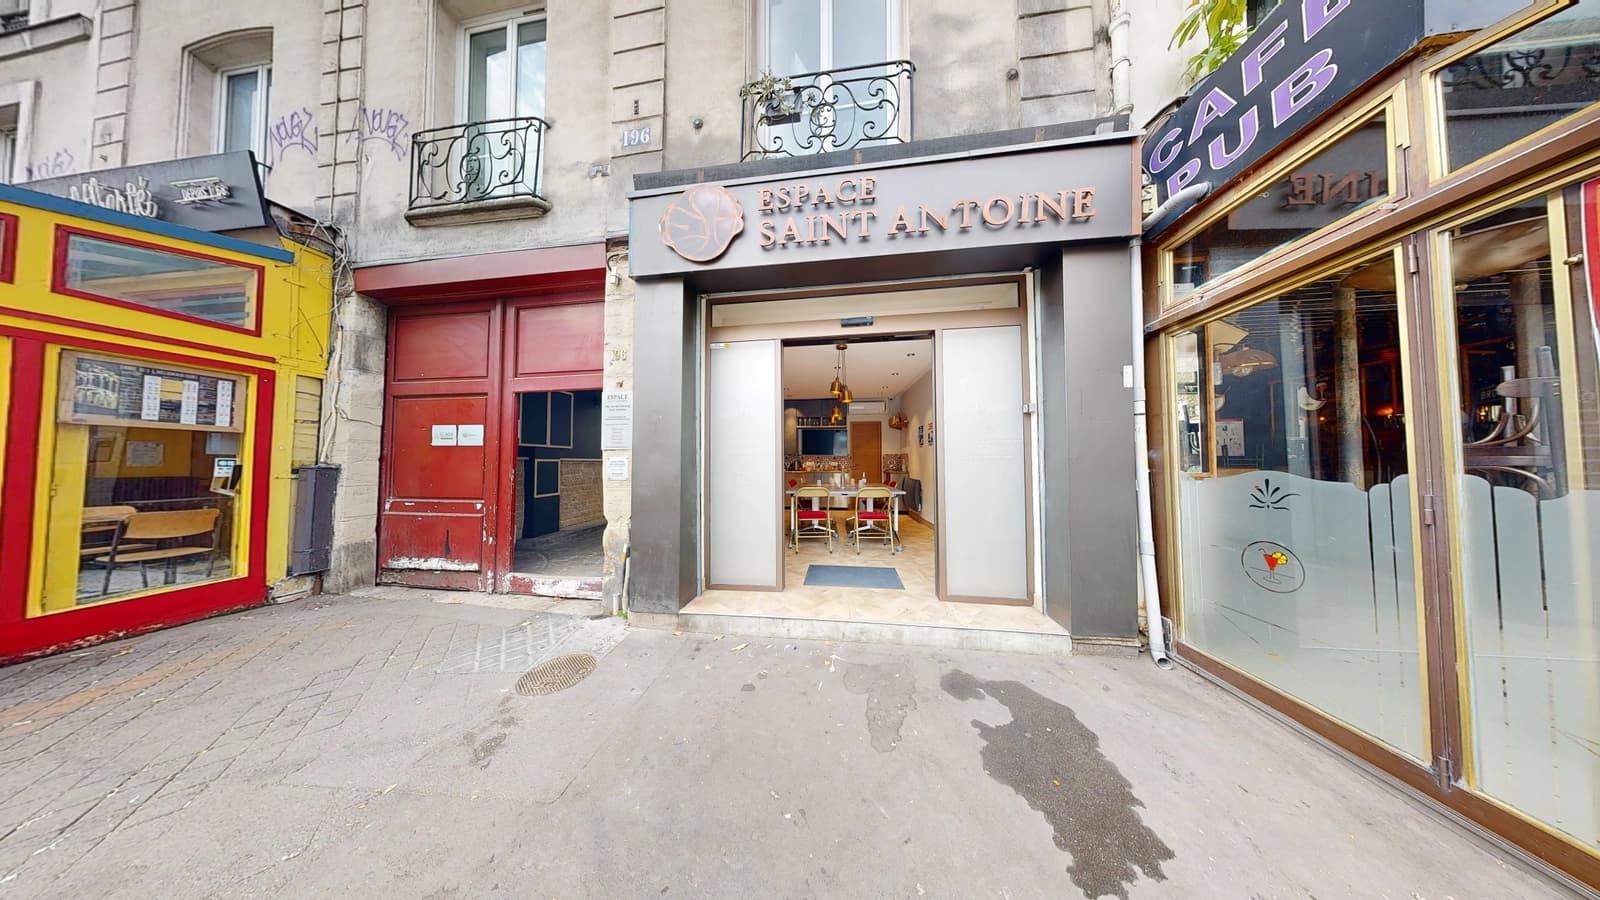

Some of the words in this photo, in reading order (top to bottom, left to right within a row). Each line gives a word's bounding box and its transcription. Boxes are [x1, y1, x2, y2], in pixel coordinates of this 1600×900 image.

[623, 128, 650, 147] 196
[1166, 48, 1338, 200] PUB
[757, 175, 878, 213] ESPACE
[758, 208, 878, 248] SAINT
[887, 185, 1098, 237] ANTOINE
